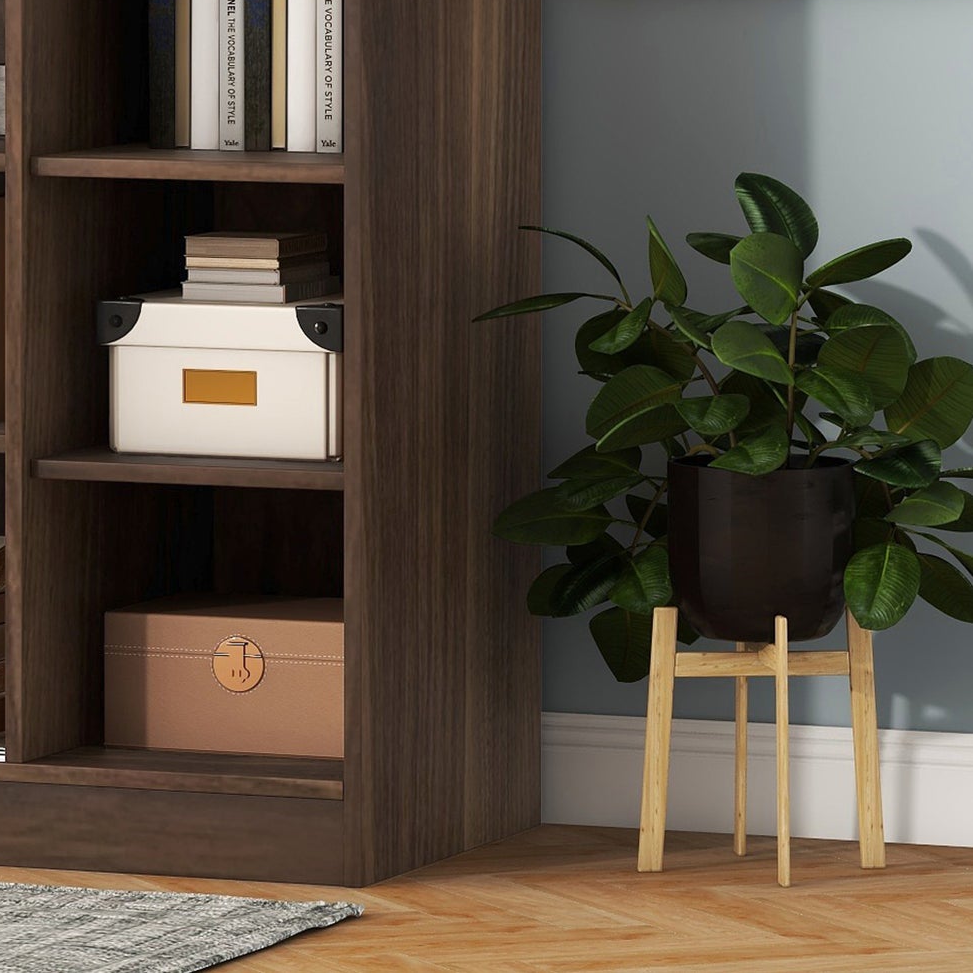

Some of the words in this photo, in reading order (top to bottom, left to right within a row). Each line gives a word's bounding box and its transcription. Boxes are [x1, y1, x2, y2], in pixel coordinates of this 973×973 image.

[227, 18, 235, 32] THE
[324, 7, 332, 74] VOCABULARY
[227, 33, 235, 86] VOCABULARY
[324, 76, 332, 89] OF
[227, 88, 235, 99] OF
[227, 100, 235, 125] STYLE
[324, 91, 332, 120] STYLE
[224, 139, 239, 147] Yale
[321, 139, 336, 148] Yale
